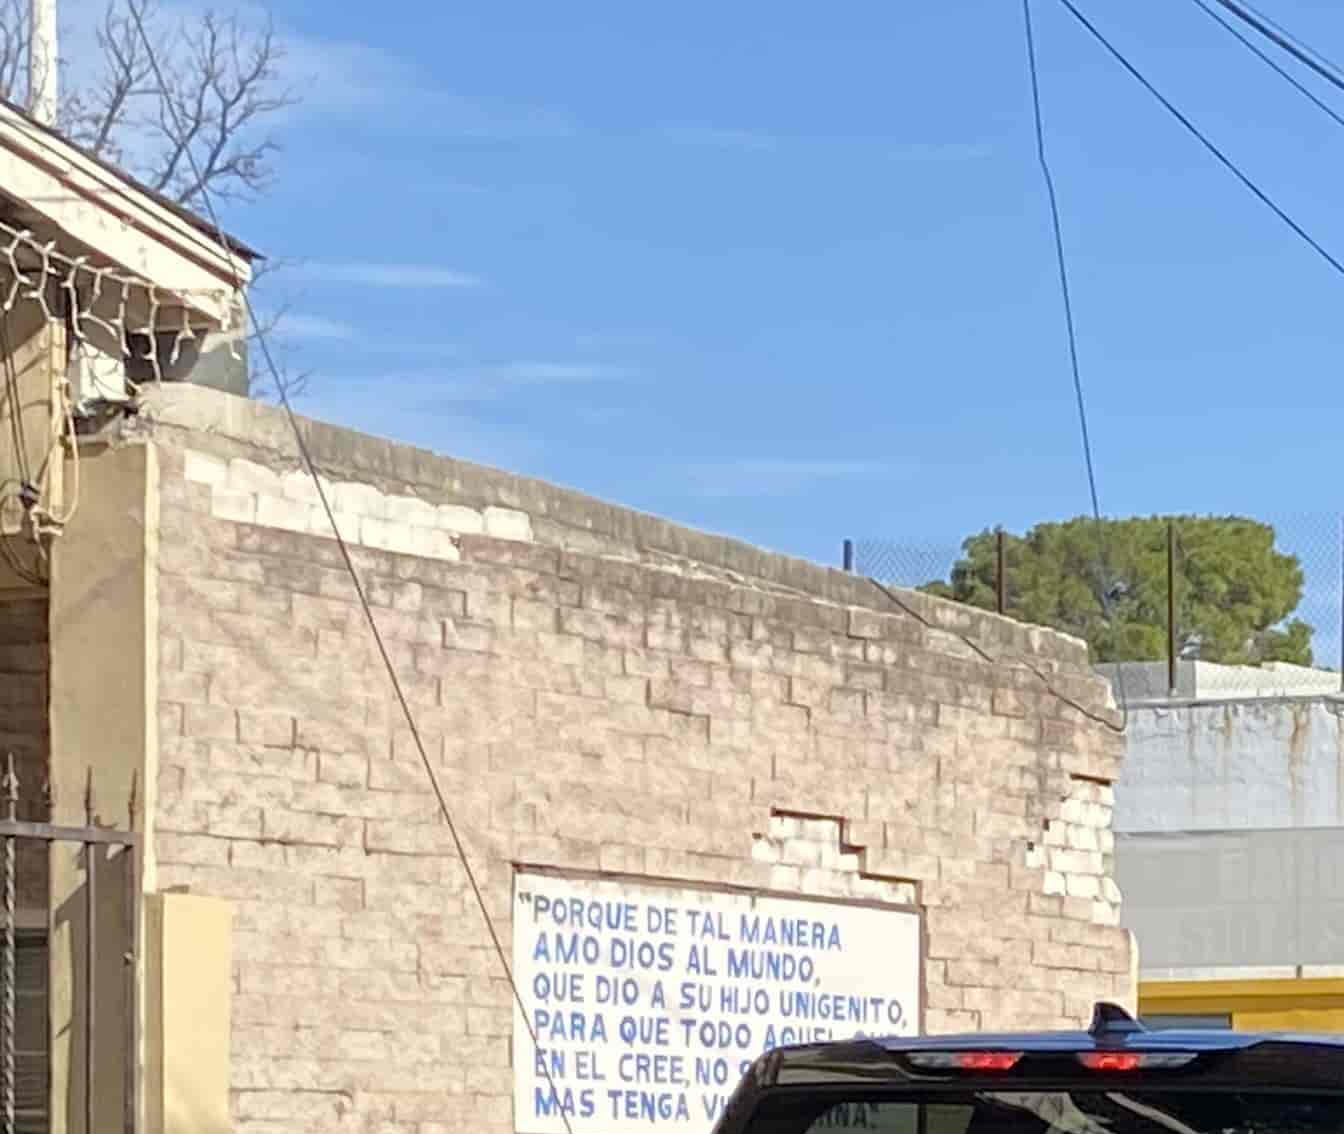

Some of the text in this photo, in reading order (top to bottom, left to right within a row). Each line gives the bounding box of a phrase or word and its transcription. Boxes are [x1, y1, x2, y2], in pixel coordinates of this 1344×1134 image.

[647, 905, 678, 936] DE
[686, 909, 731, 942] TAL
[739, 914, 842, 952] MANERA
[533, 932, 822, 988] AMO DIOS AL MUNDO,
[533, 973, 909, 1030] QUE DIO A SU HIJO UNIGENITO,
[534, 1010, 609, 1044] PARA
[619, 1015, 670, 1048] QUE
[680, 1019, 752, 1050] TODO
[535, 1049, 566, 1080] EN
[575, 1051, 607, 1082] EL
[618, 1053, 692, 1089] CREE,
[695, 1056, 729, 1087] NO
[535, 1088, 595, 1119] MAS
[607, 1090, 691, 1125] TENGA
